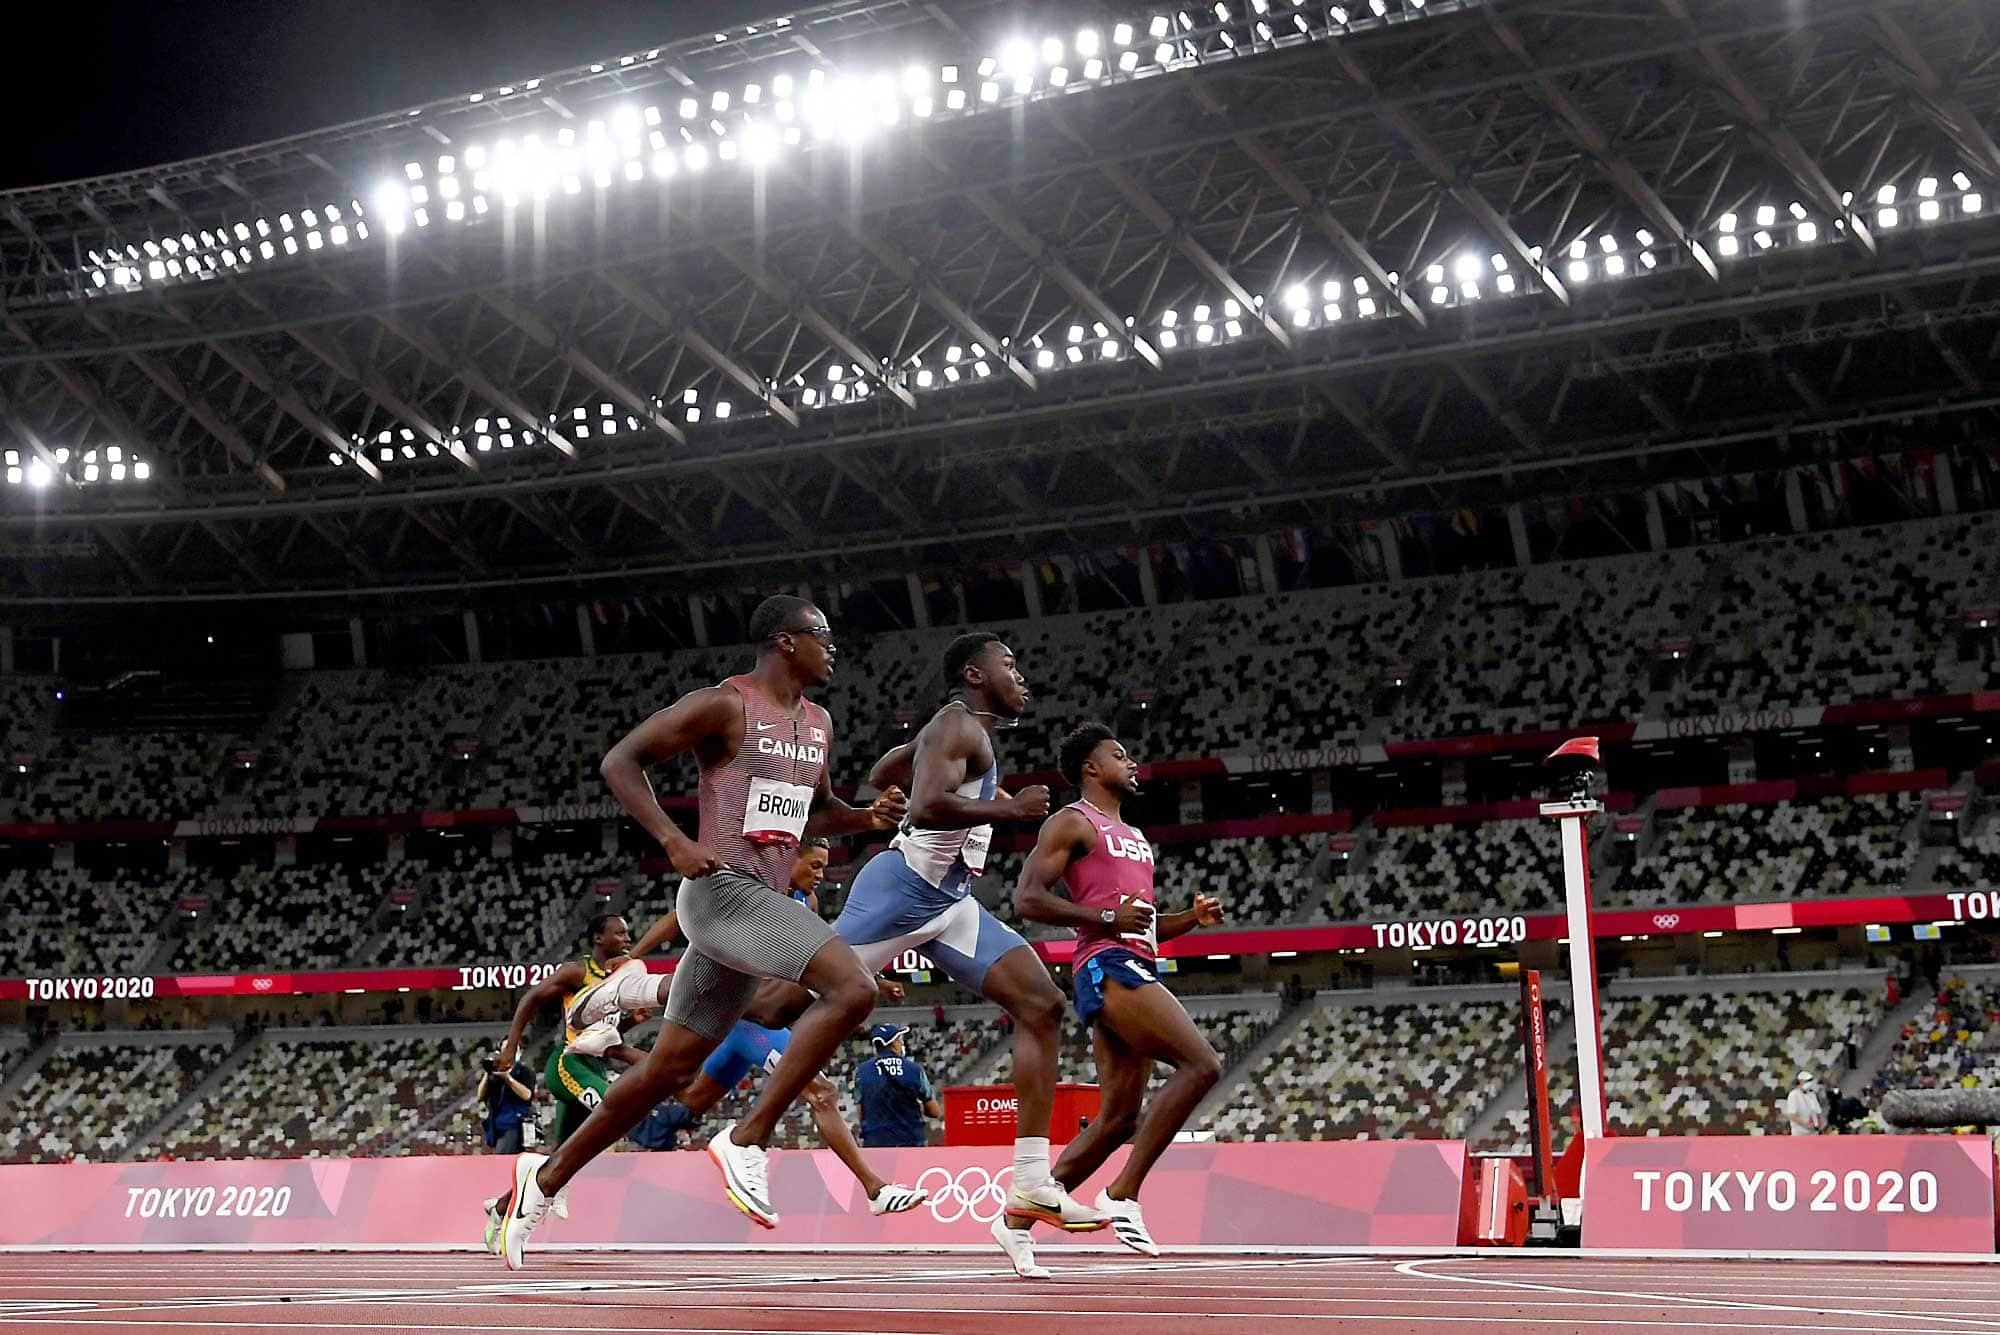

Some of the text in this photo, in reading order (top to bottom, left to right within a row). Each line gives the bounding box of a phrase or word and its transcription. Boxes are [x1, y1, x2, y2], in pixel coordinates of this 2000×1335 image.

[1742, 710, 1793, 731] 2020
[758, 737, 824, 765] CANADA
[1316, 747, 1361, 767] 2020
[758, 793, 806, 819] BROWN
[1105, 834, 1155, 865] USA
[1372, 916, 1526, 948] TOKYO 2020
[26, 976, 154, 1000] TOKYO 2020
[460, 965, 526, 988] TOKYO
[1533, 1006, 1543, 1072] OMEGA
[583, 1092, 599, 1108] 2
[125, 1186, 292, 1218] TOKYO 2020
[1633, 1169, 1939, 1213] TOKYO 2020
